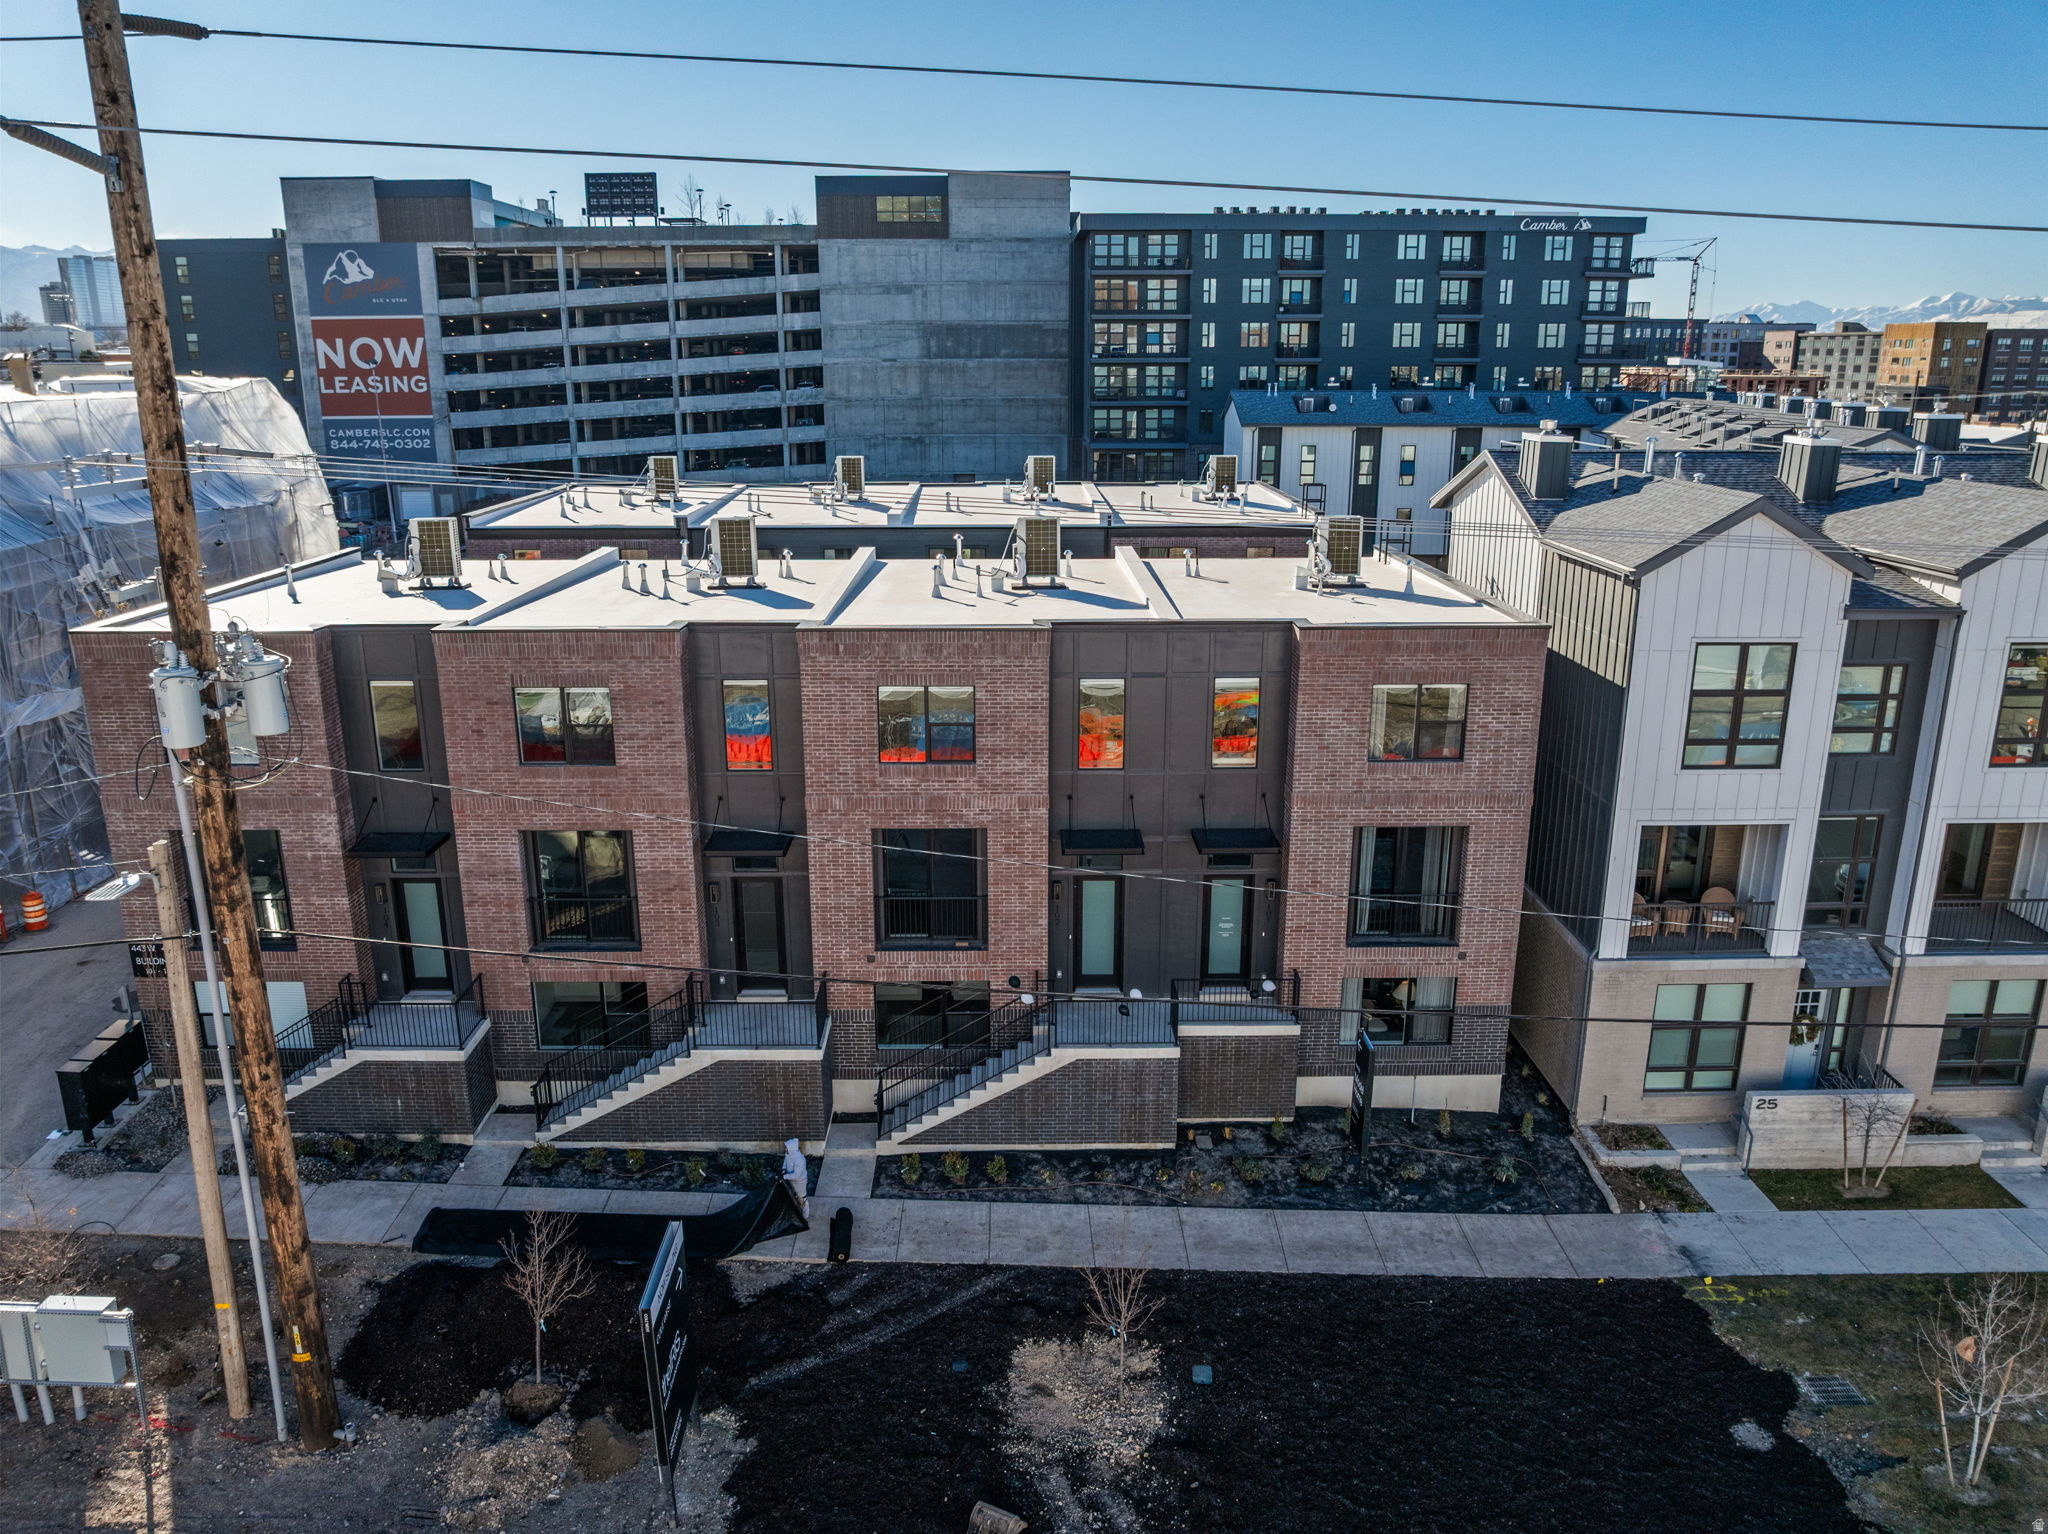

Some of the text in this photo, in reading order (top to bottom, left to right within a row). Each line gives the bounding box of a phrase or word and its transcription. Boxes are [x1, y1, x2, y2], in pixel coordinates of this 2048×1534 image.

[1520, 218, 1567, 230] Camber
[315, 336, 424, 370] NOW
[320, 375, 428, 393] LEASING
[329, 428, 430, 438] CAMBERSLC.COM
[330, 439, 431, 449] 844-745-0302
[1755, 1099, 1778, 1109] 25
